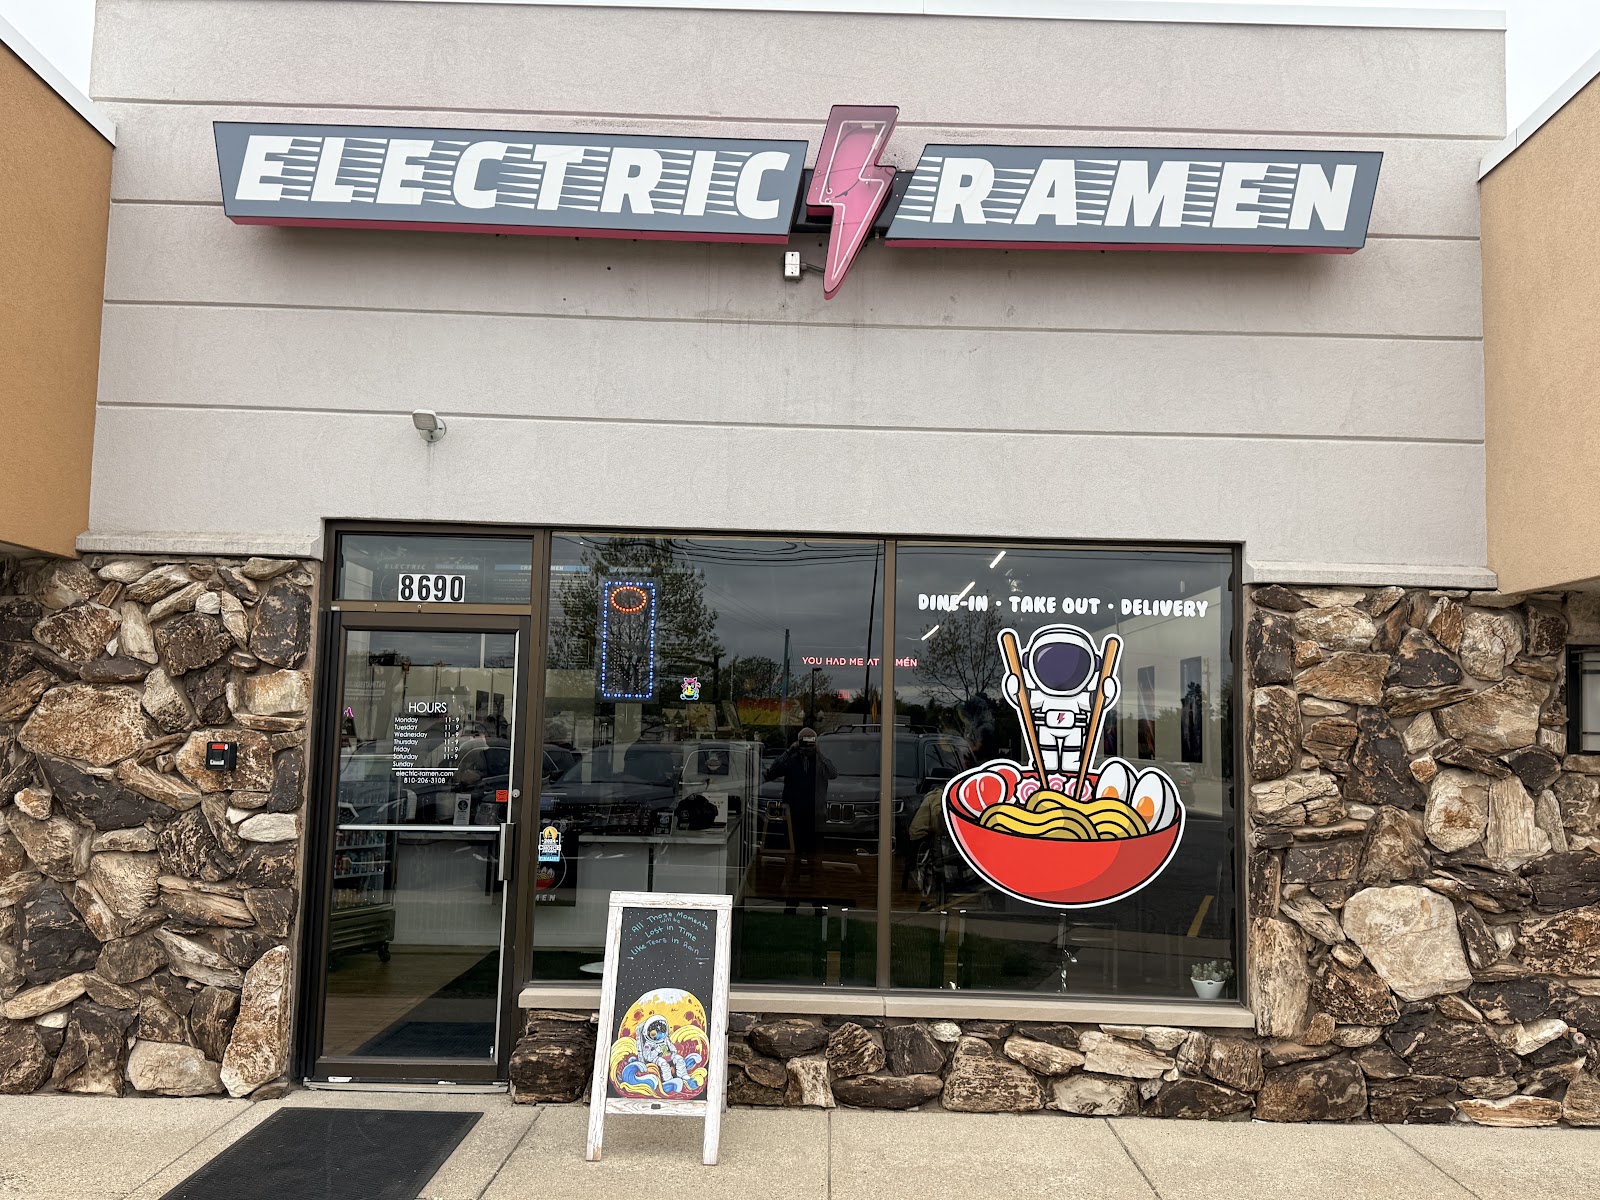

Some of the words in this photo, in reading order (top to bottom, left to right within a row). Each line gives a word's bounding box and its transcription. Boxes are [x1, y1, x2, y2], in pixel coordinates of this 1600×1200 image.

[235, 135, 790, 219] ELECTRIC
[932, 157, 1357, 231] RAMEN
[400, 574, 464, 602] 8690
[918, 593, 989, 612] DINE-IN
[1009, 595, 1057, 614] TAKE
[1062, 597, 1101, 615] OUT
[1121, 598, 1209, 618] DELIVERY
[802, 656, 823, 665] YOU
[826, 657, 847, 666] HAD
[849, 657, 864, 666] ME
[867, 658, 880, 666] AT
[408, 701, 448, 713] HOURS
[394, 716, 419, 724] Monday
[392, 760, 415, 768] Sunday
[395, 769, 454, 777] electric-ramen.com
[631, 921, 644, 933] All
[646, 911, 673, 923] Those
[676, 911, 709, 931] Moments
[644, 926, 664, 938] Lost
[678, 925, 697, 942] Time
[630, 943, 647, 955] Like
[646, 937, 668, 946] Tears
[671, 936, 680, 944] in
[683, 941, 700, 956] Rain
